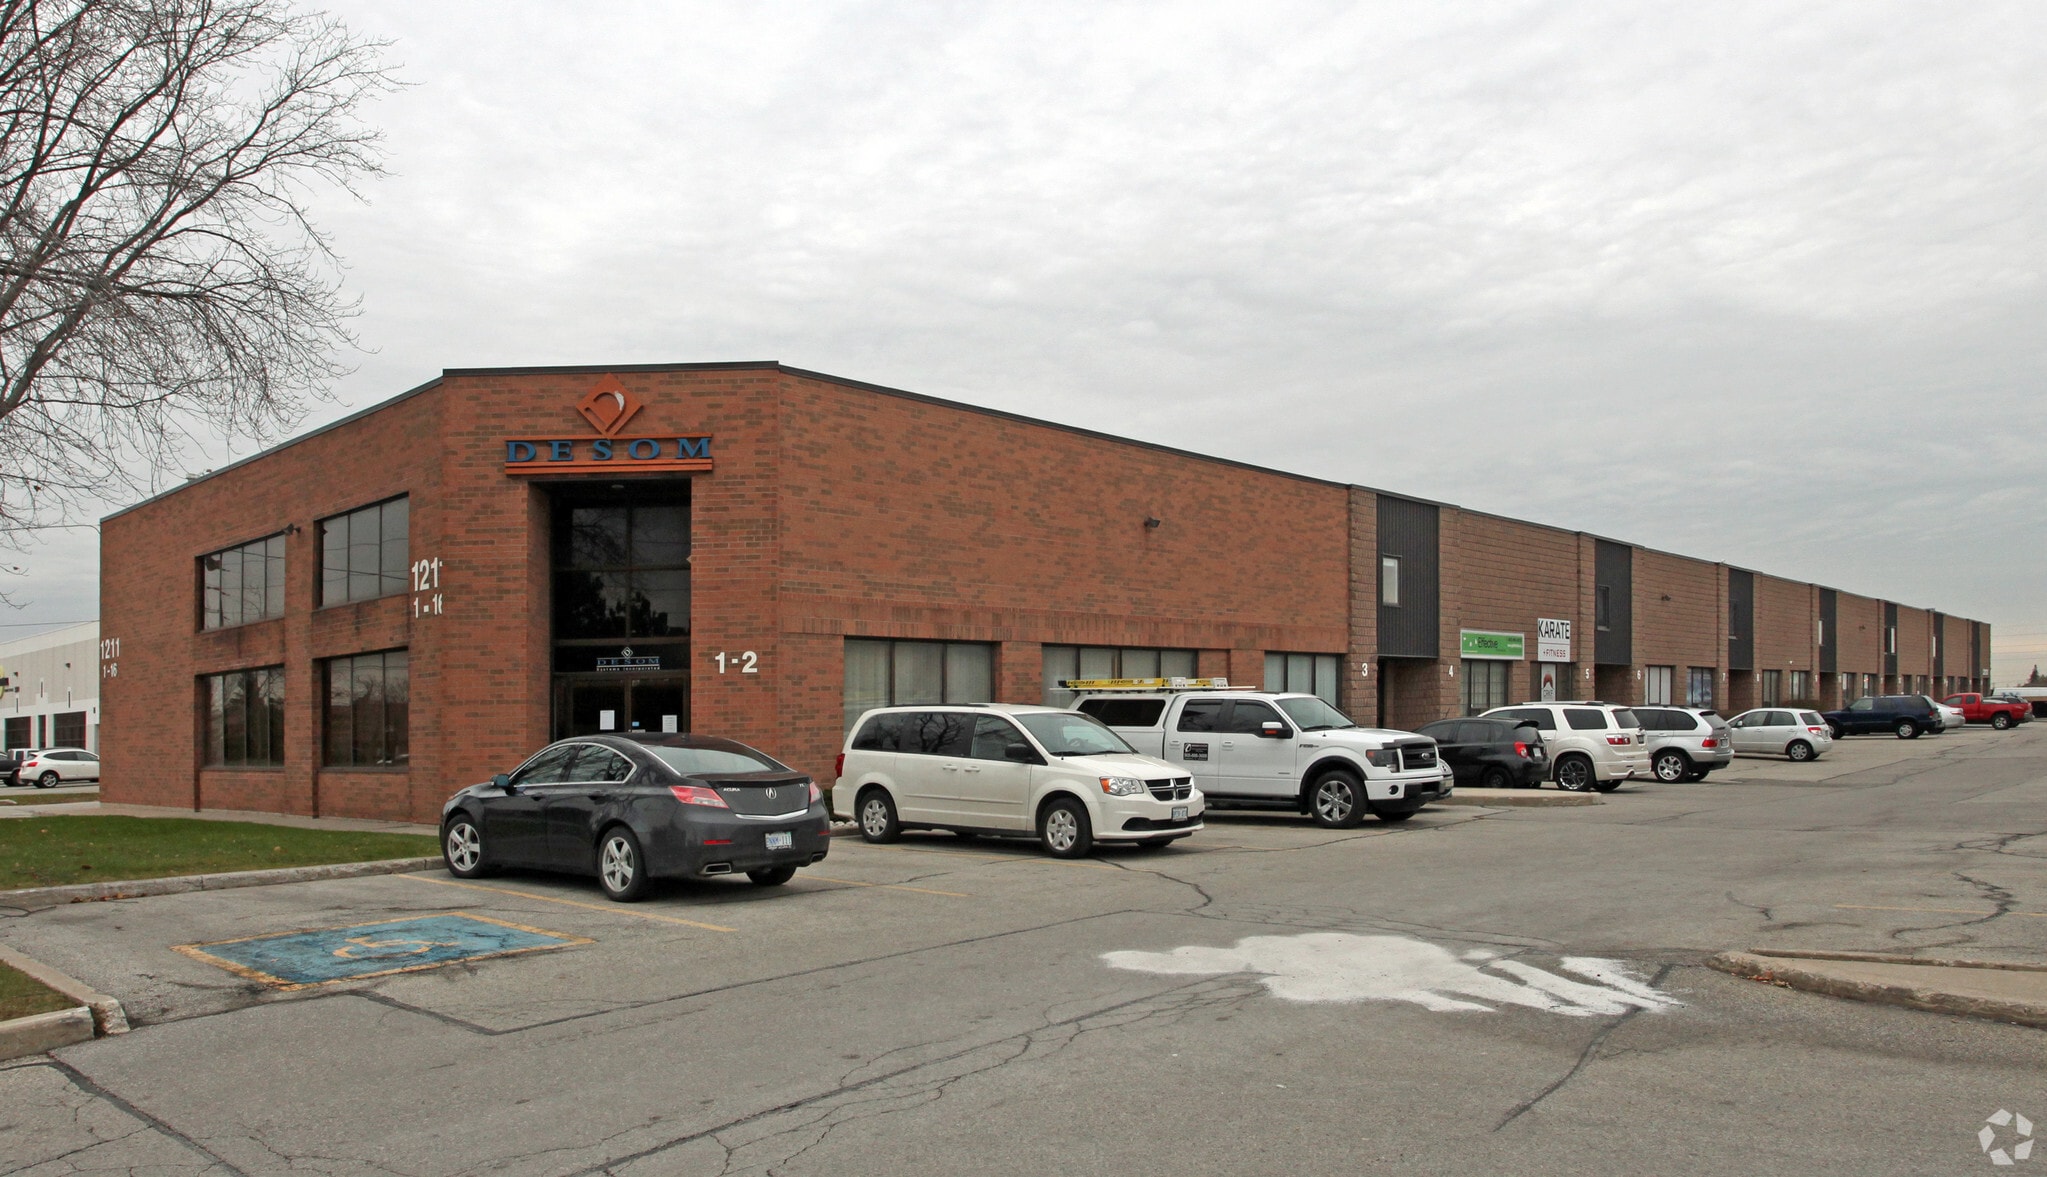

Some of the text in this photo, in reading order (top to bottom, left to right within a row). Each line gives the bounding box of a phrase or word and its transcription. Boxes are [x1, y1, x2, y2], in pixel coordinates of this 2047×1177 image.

[506, 438, 713, 463] DESOM
[411, 557, 443, 592] 121
[1537, 620, 1570, 640] KARATE
[100, 637, 120, 660] 1211
[597, 658, 659, 666] DESOM
[1361, 662, 1368, 677] 3
[1448, 664, 1454, 678] 4
[1585, 668, 1590, 680] 5
